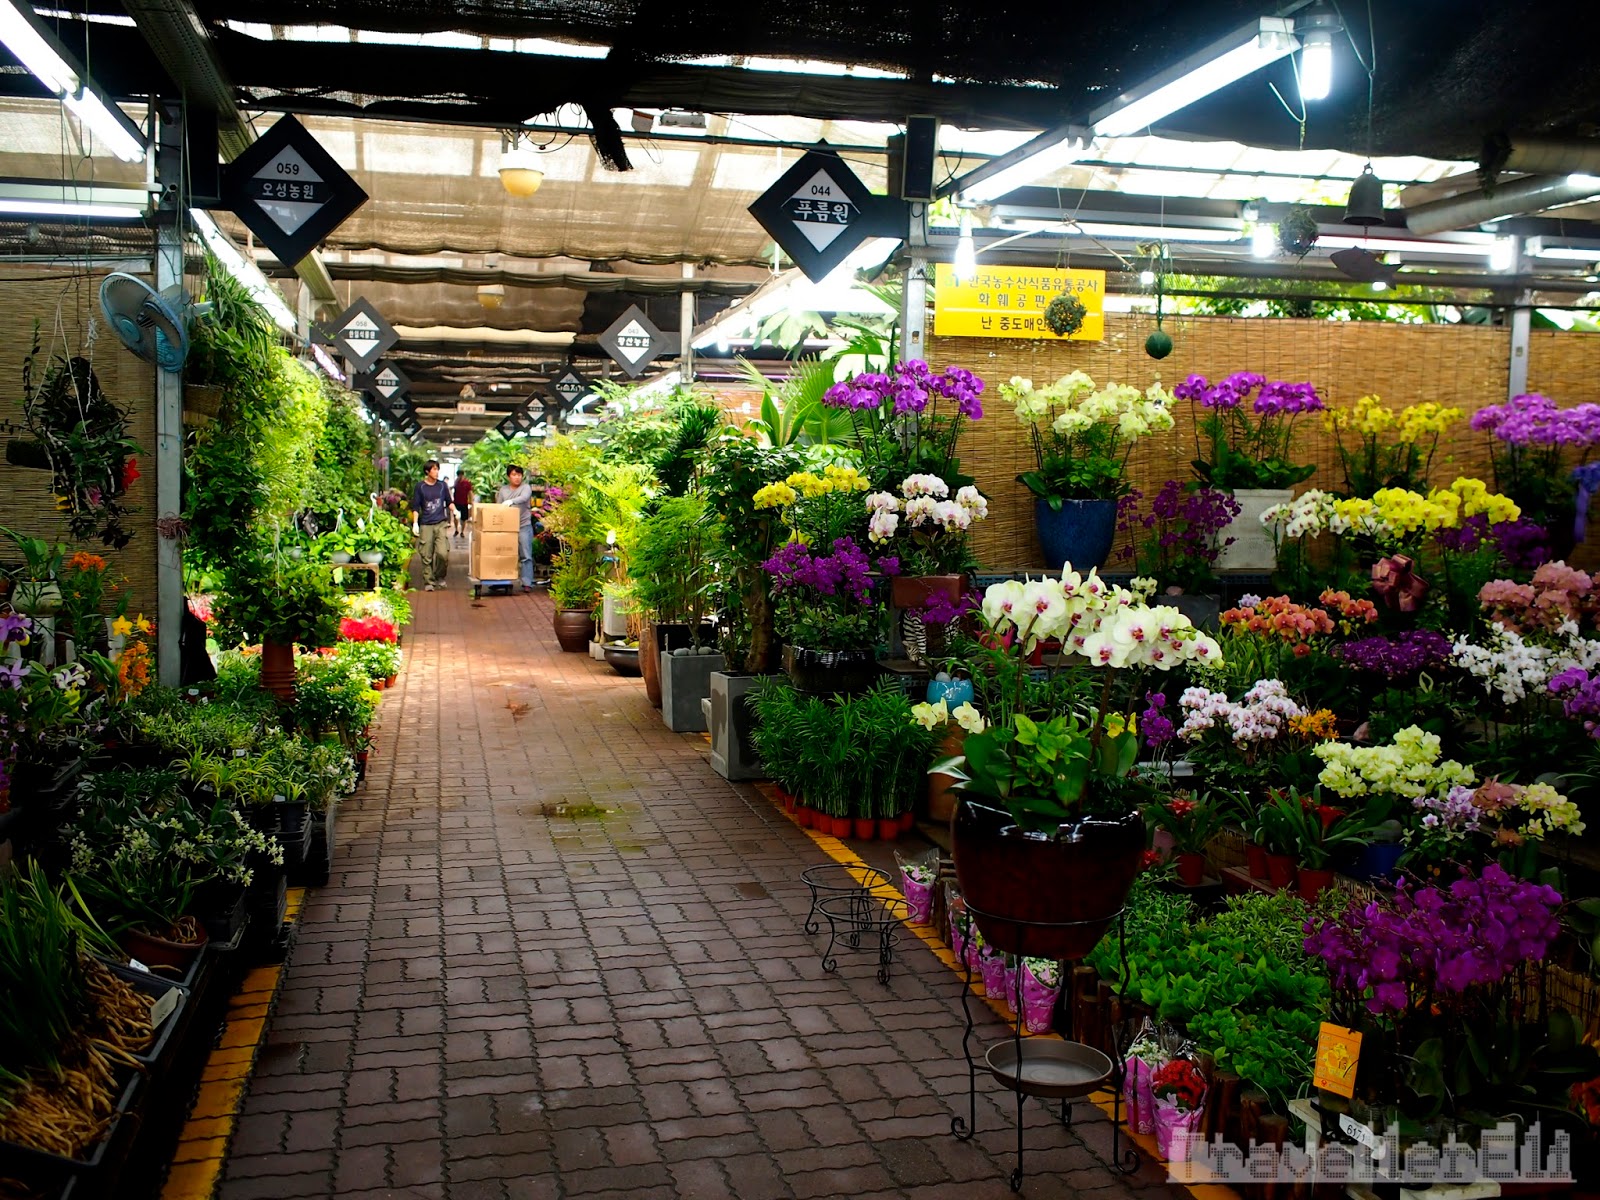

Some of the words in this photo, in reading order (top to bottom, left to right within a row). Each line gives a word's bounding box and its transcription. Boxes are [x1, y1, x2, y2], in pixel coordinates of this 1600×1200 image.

[276, 162, 300, 175] 059
[262, 182, 314, 200] 오성농원
[811, 184, 831, 196] 044
[793, 200, 849, 223] 푸름원
[981, 316, 992, 330] 난
